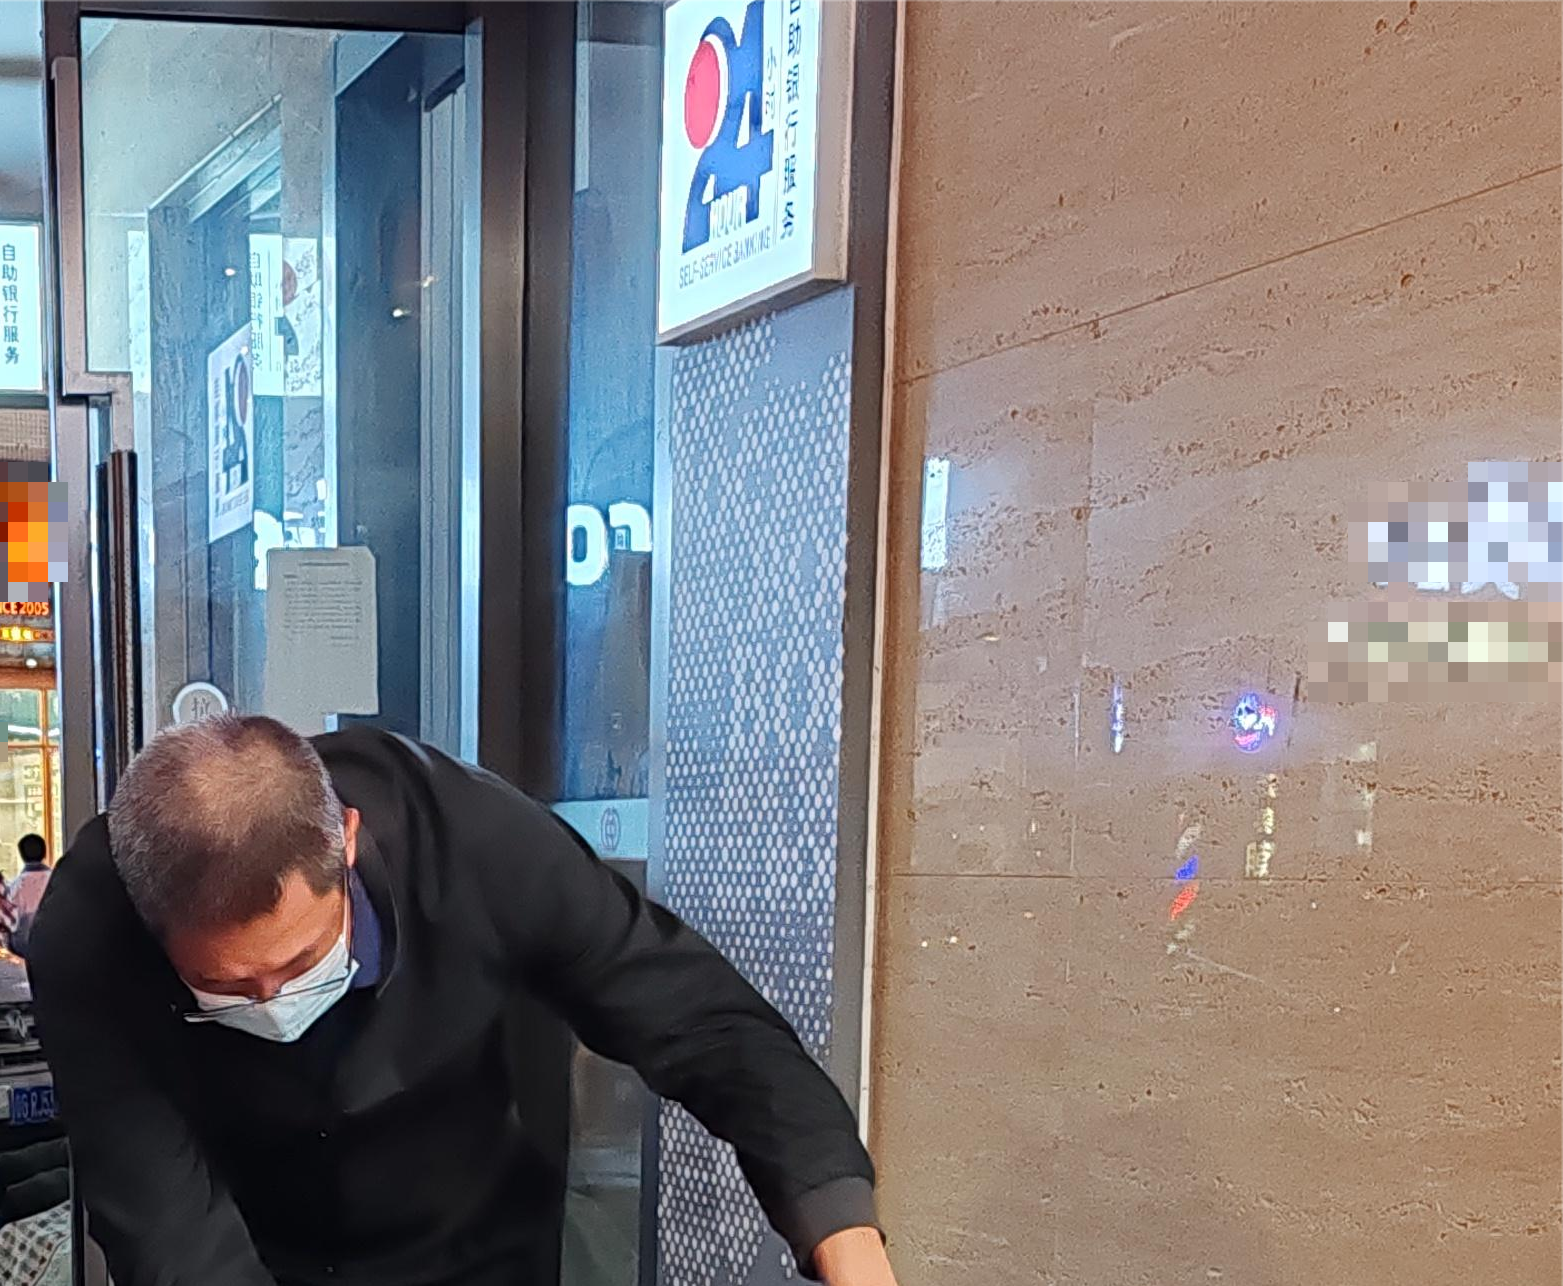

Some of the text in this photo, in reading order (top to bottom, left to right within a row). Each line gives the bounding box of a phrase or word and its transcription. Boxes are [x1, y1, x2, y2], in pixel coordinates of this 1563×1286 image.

[683, 0, 774, 254] 24
[2, 243, 20, 364] 自助银行服务
